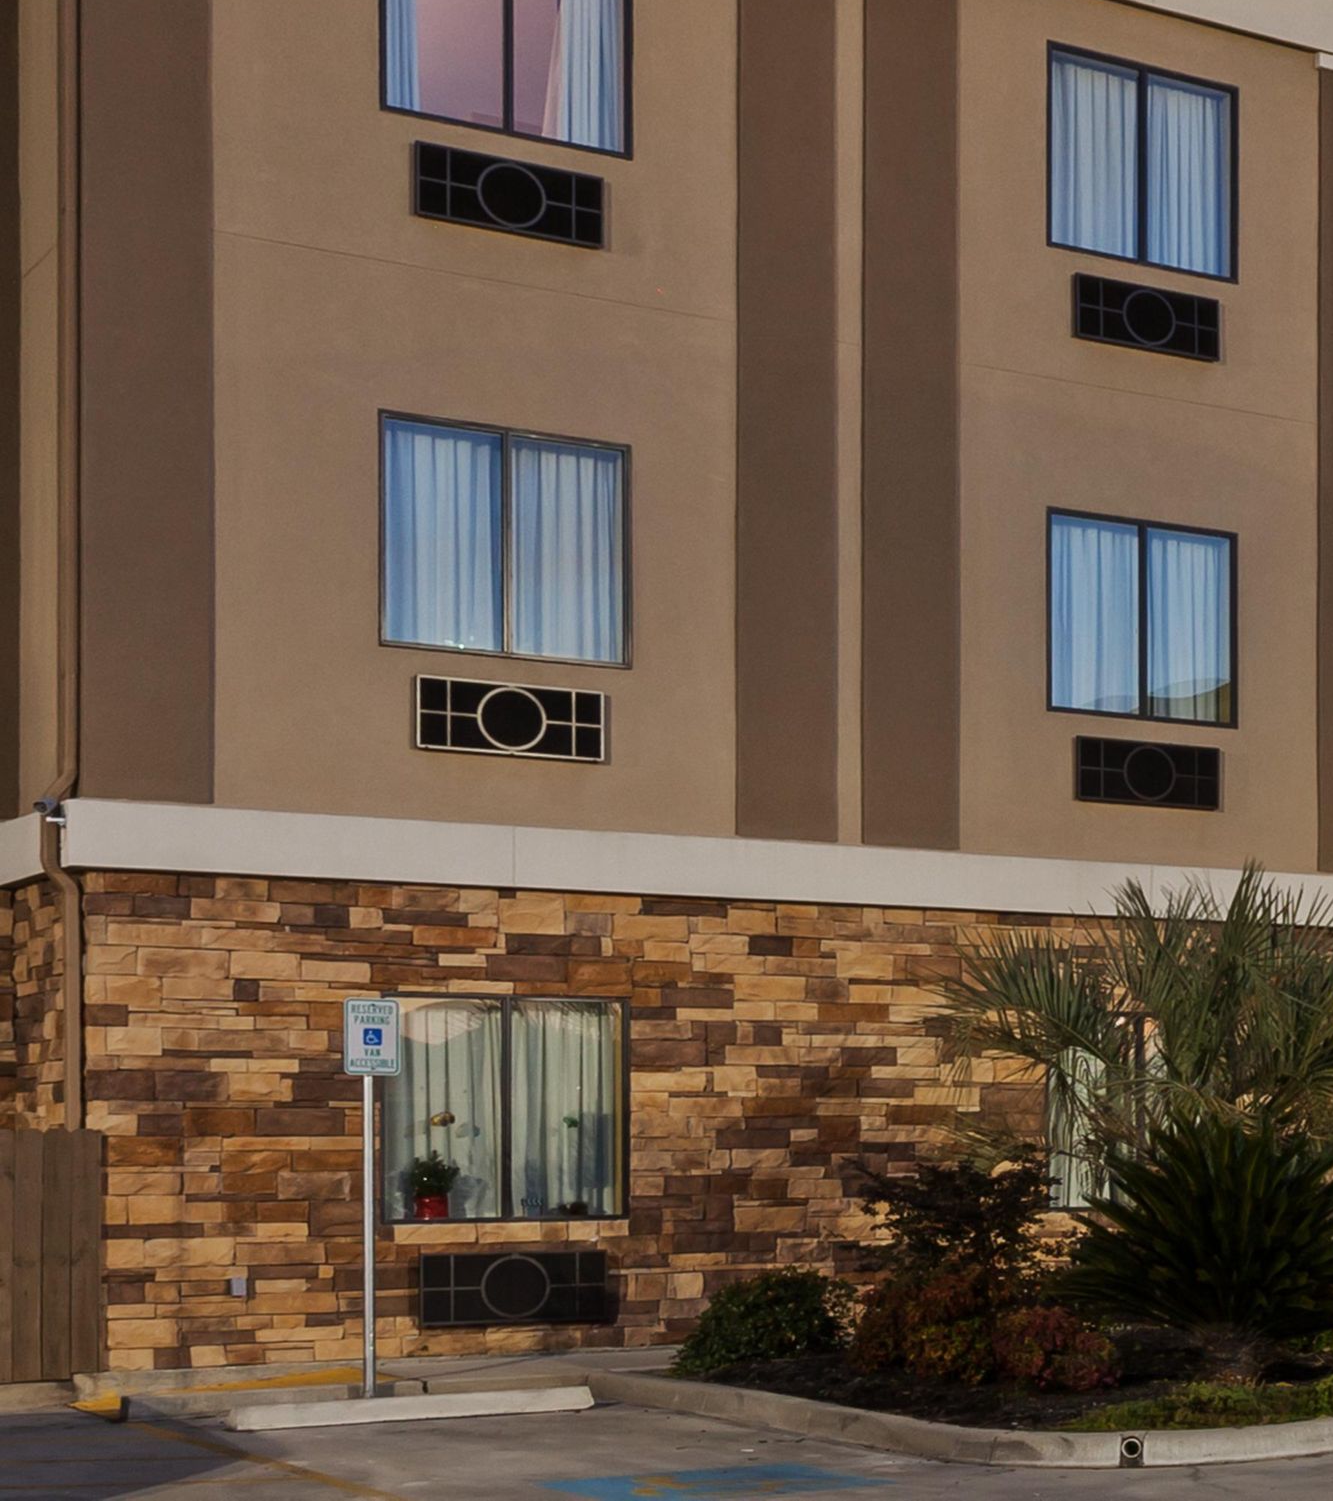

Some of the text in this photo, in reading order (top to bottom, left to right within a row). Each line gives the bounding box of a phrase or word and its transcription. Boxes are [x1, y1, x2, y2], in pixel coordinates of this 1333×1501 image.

[350, 1004, 393, 1014] RESERVED
[354, 1015, 391, 1025] PARKING
[364, 1048, 381, 1057] VAN
